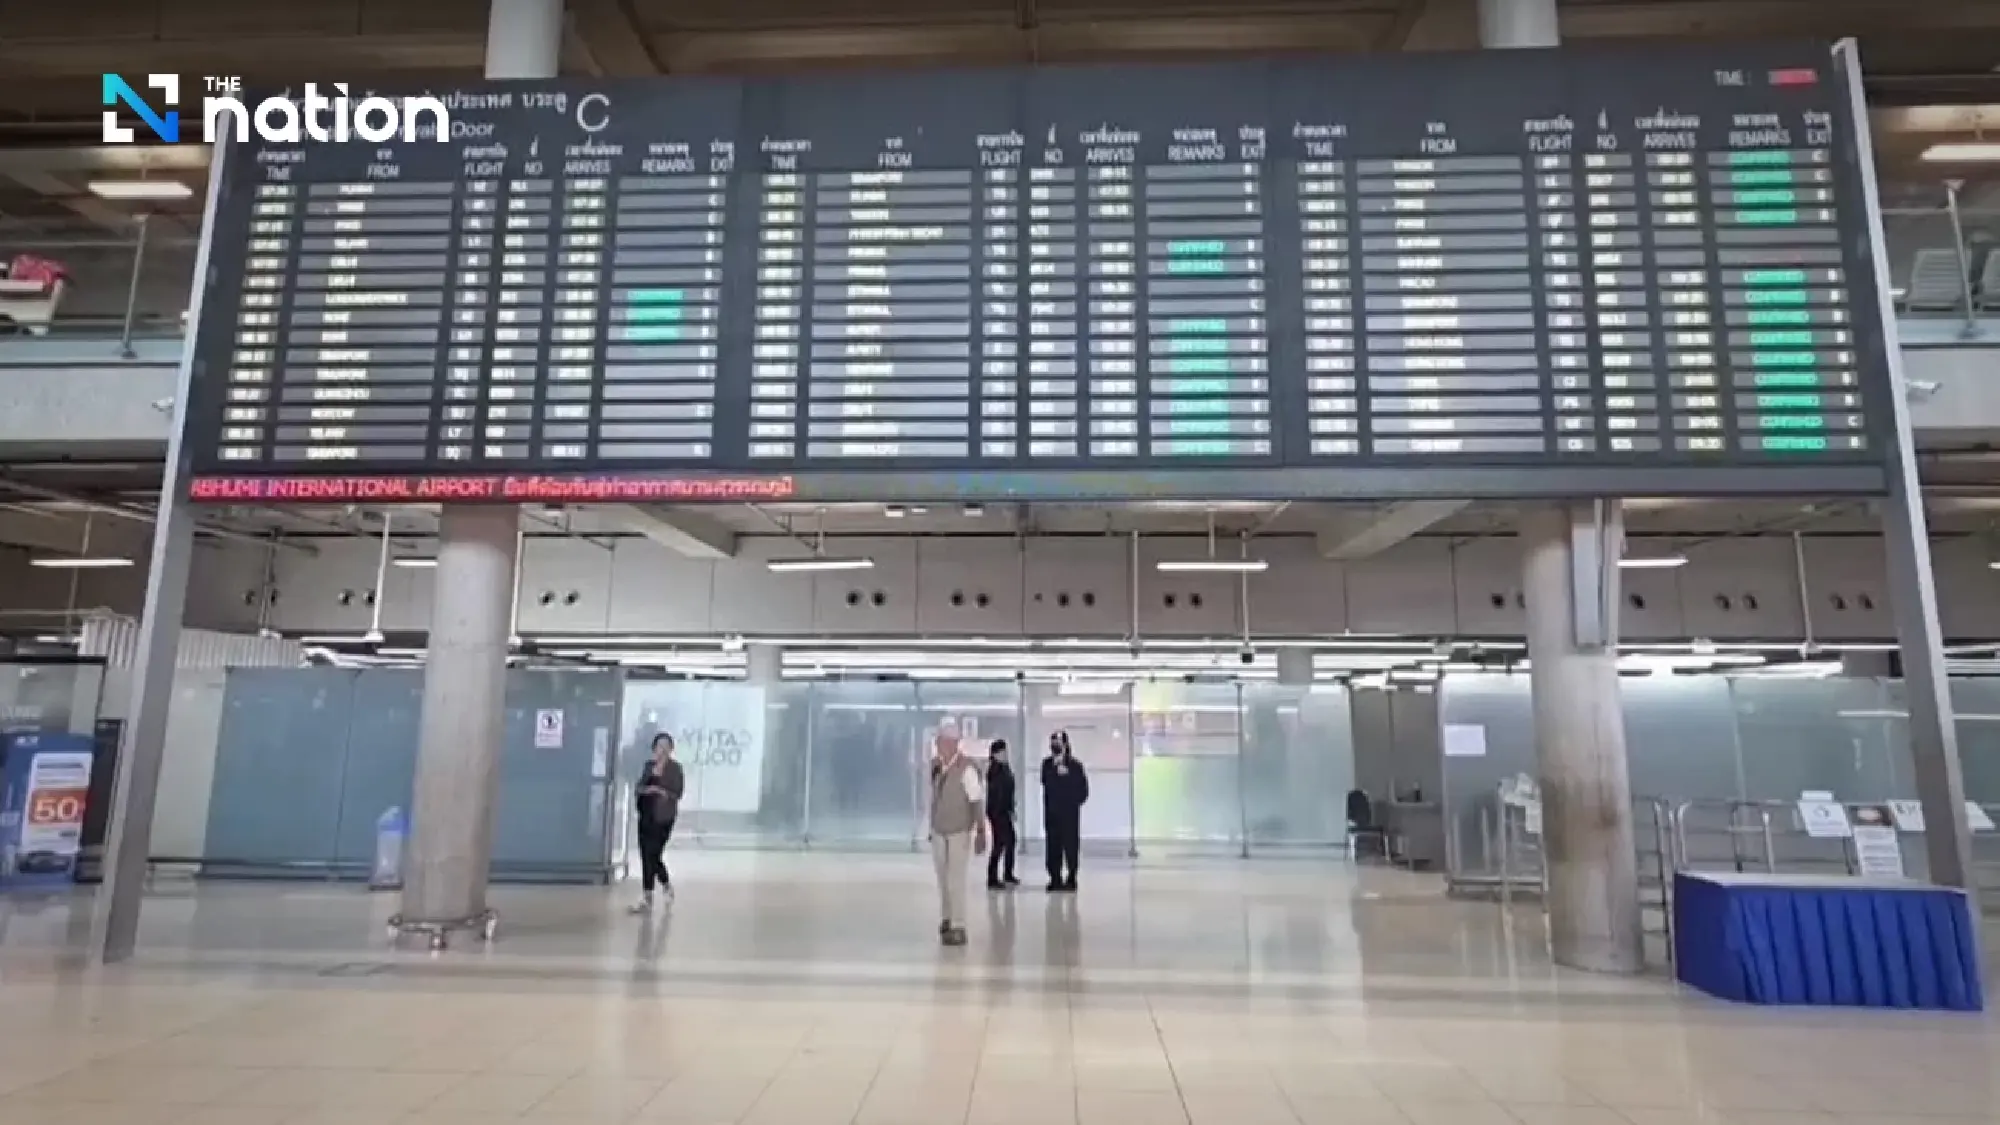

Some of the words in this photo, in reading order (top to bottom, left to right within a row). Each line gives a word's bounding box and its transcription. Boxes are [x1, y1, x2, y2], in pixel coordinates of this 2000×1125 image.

[576, 93, 611, 132] C
[450, 119, 495, 138] Door
[266, 478, 411, 497] INTERNATIONAL
[416, 478, 494, 497] AIRPORT
[35, 796, 79, 821] 50
